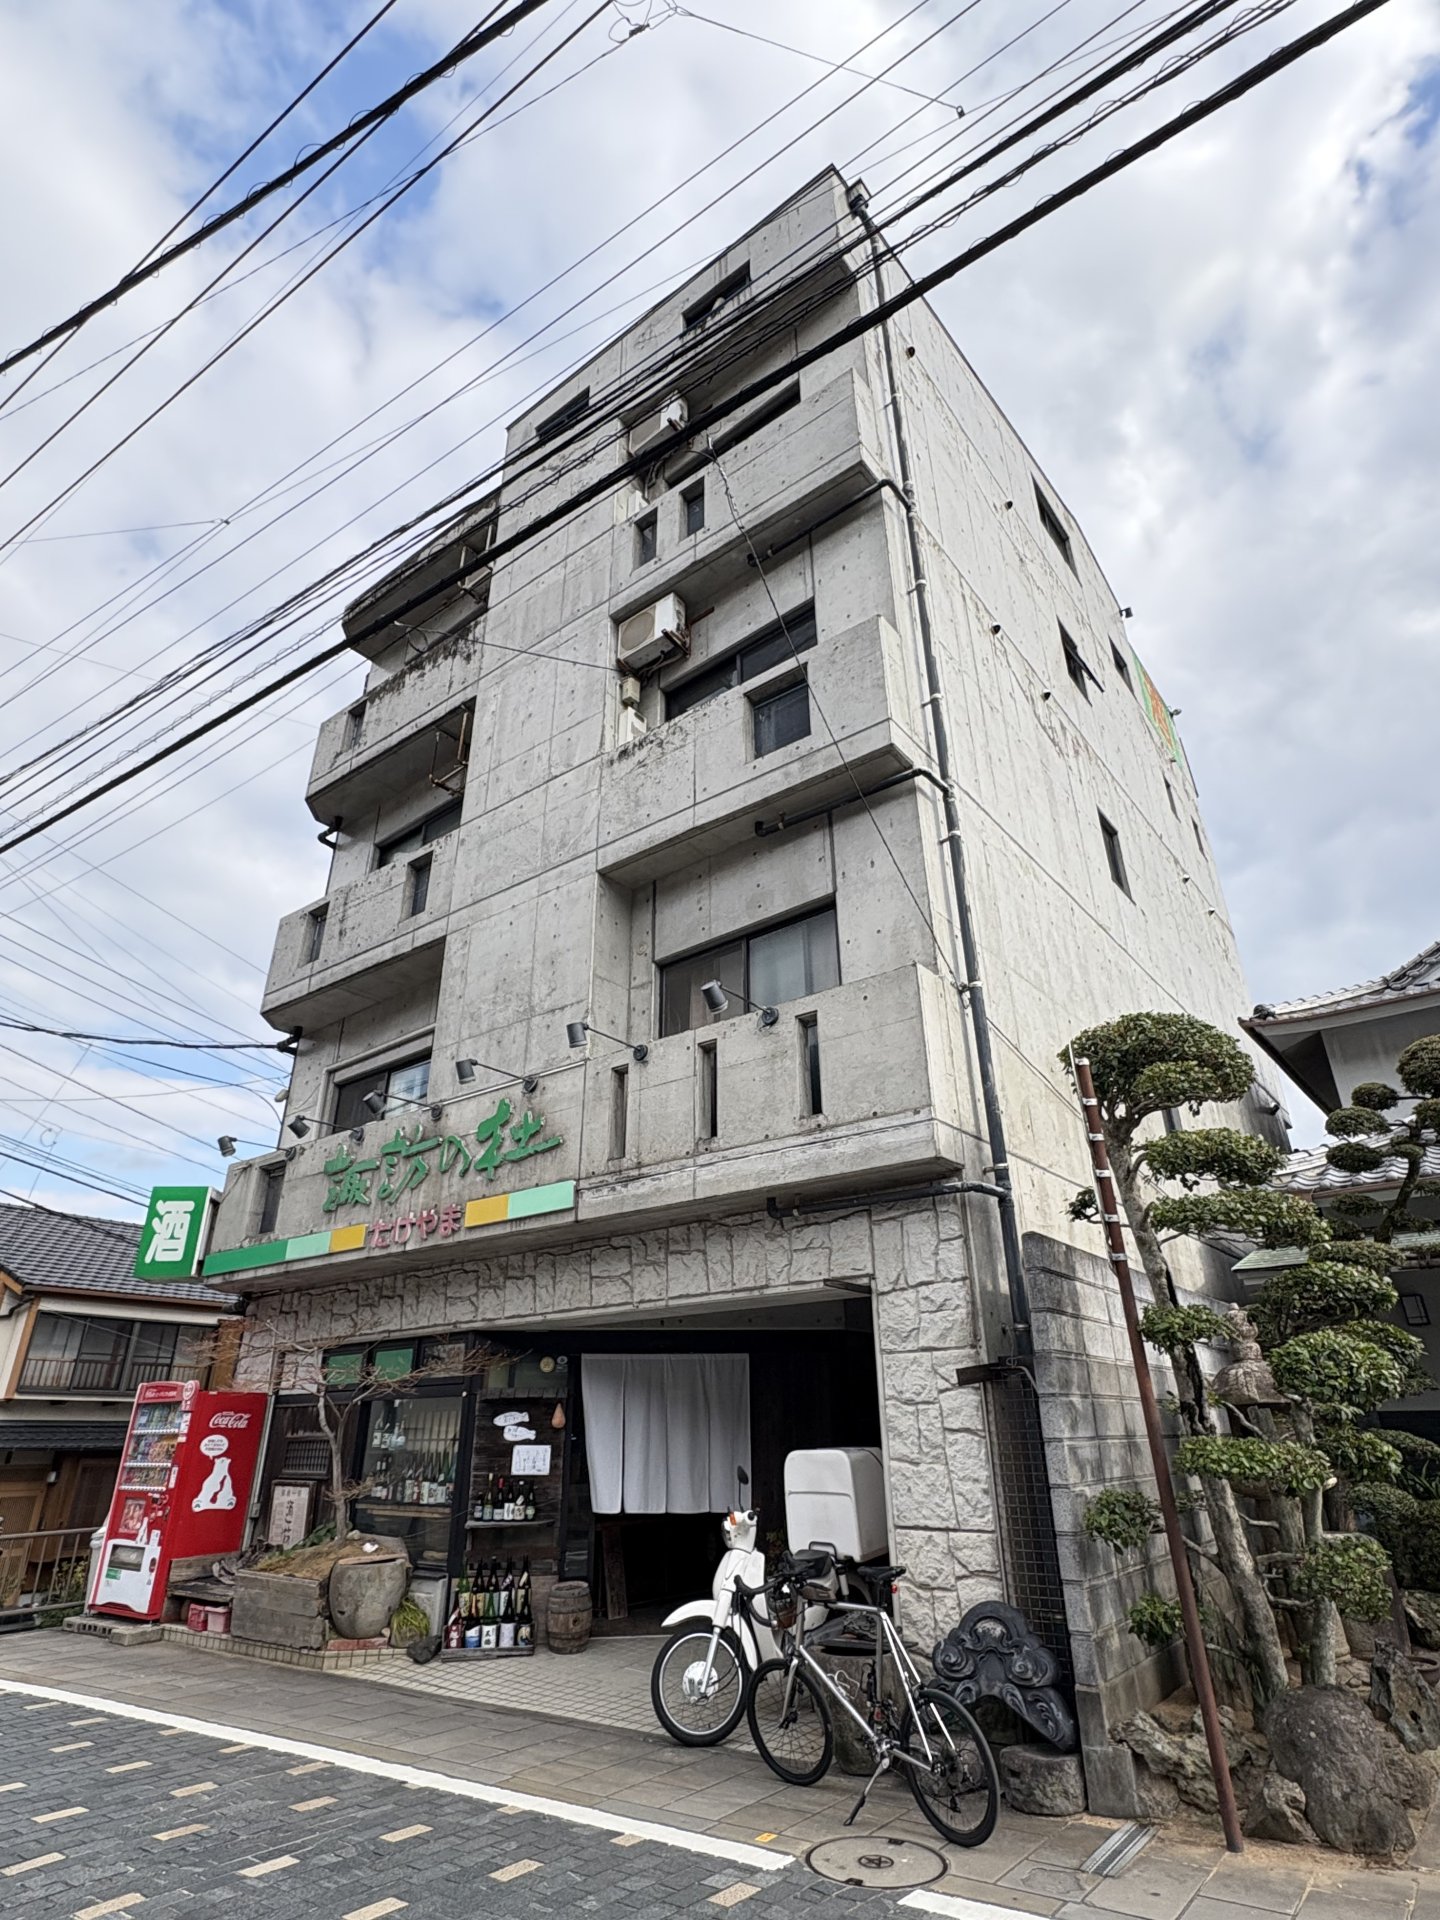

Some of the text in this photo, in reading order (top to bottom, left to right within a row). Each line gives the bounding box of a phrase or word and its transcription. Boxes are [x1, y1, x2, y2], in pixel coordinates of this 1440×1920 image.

[145, 1199, 195, 1264] 酒
[370, 1203, 463, 1249] たけやま
